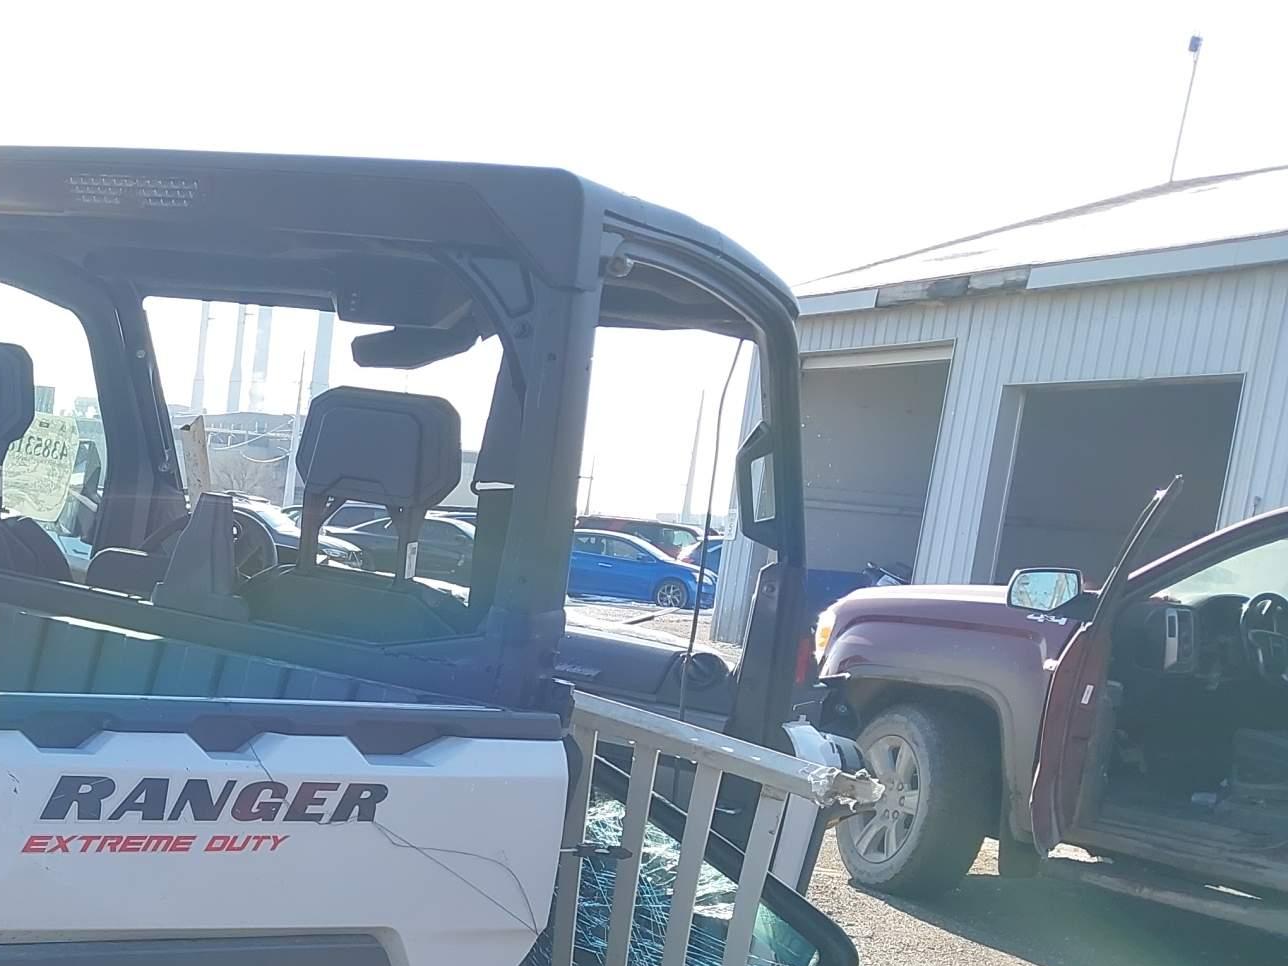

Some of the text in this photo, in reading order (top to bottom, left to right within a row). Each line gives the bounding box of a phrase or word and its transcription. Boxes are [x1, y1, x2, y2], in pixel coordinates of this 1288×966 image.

[39, 775, 389, 822] RANGER
[21, 834, 290, 853] EXTREME DUTY
